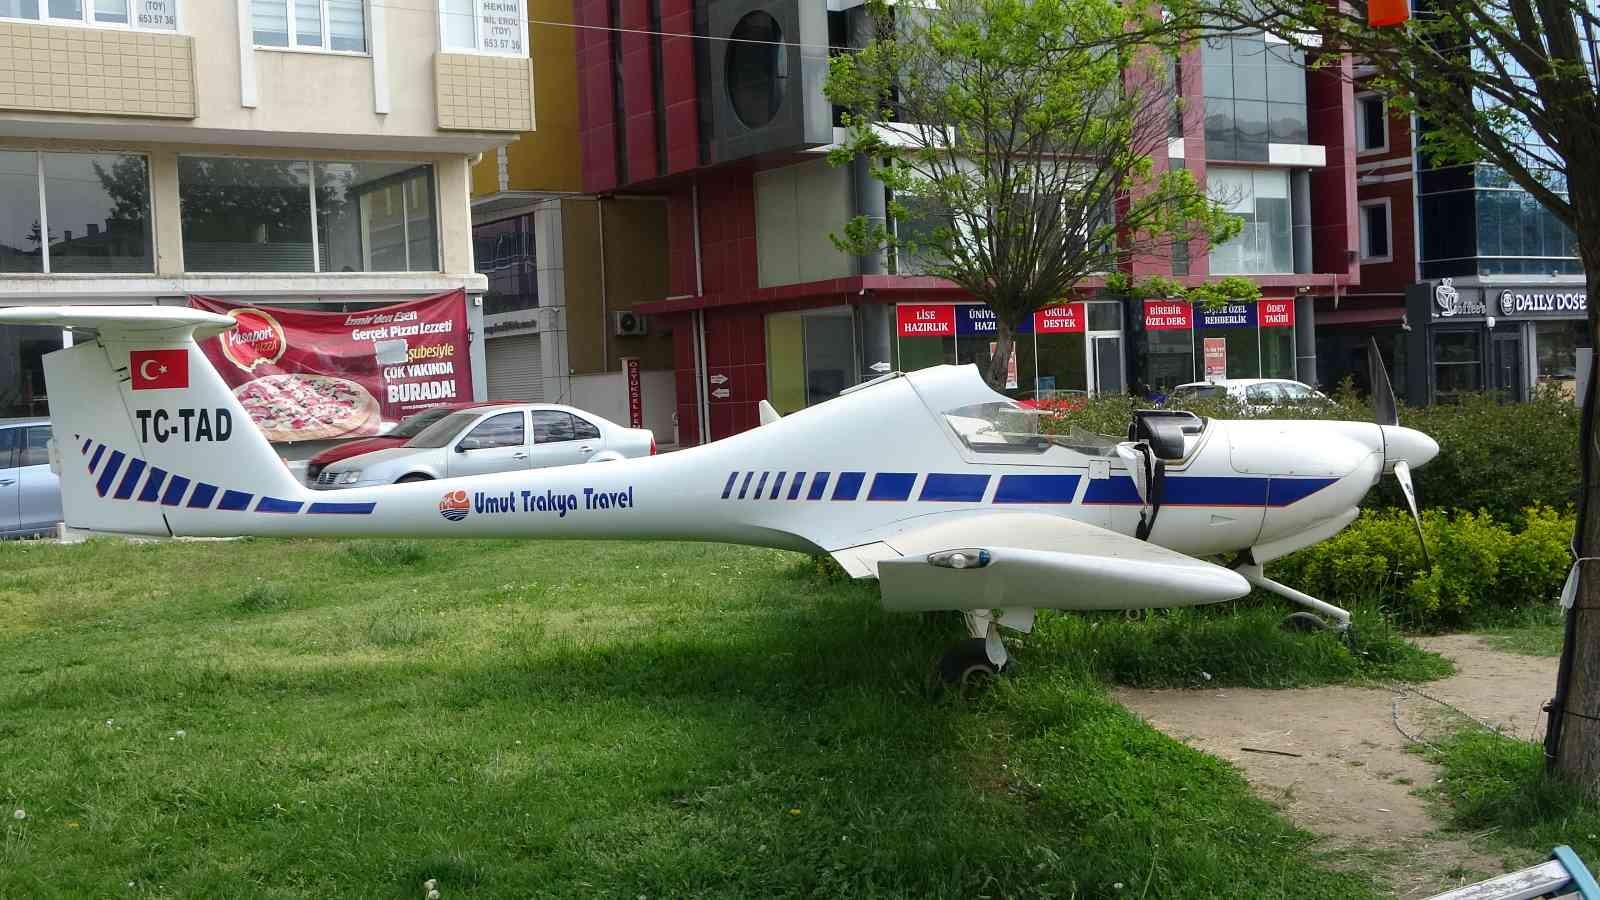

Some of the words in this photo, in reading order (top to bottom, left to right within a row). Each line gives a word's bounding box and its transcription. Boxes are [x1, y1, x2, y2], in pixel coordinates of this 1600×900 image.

[1266, 303, 1287, 313] ÖDEV
[1515, 294, 1554, 311] DAILY
[916, 308, 936, 320] LİSE
[1228, 304, 1248, 315] ÖZEL
[393, 310, 418, 322] Esen
[1166, 317, 1187, 326] DERS
[1204, 315, 1248, 325] REHBERLİK
[904, 322, 949, 332] HAZIRLIK
[1043, 319, 1077, 329] DESTEK
[352, 326, 389, 342] Gerçek
[390, 323, 419, 338] Pizza
[419, 319, 454, 335] Lezzeti
[383, 366, 406, 383] ÇOK
[407, 361, 454, 379] YAKINDA
[387, 379, 456, 403] BURADA!
[135, 408, 232, 443] TC-TAD
[474, 491, 516, 514] Umut
[521, 489, 578, 518] Trakya
[584, 486, 633, 510] Travel
